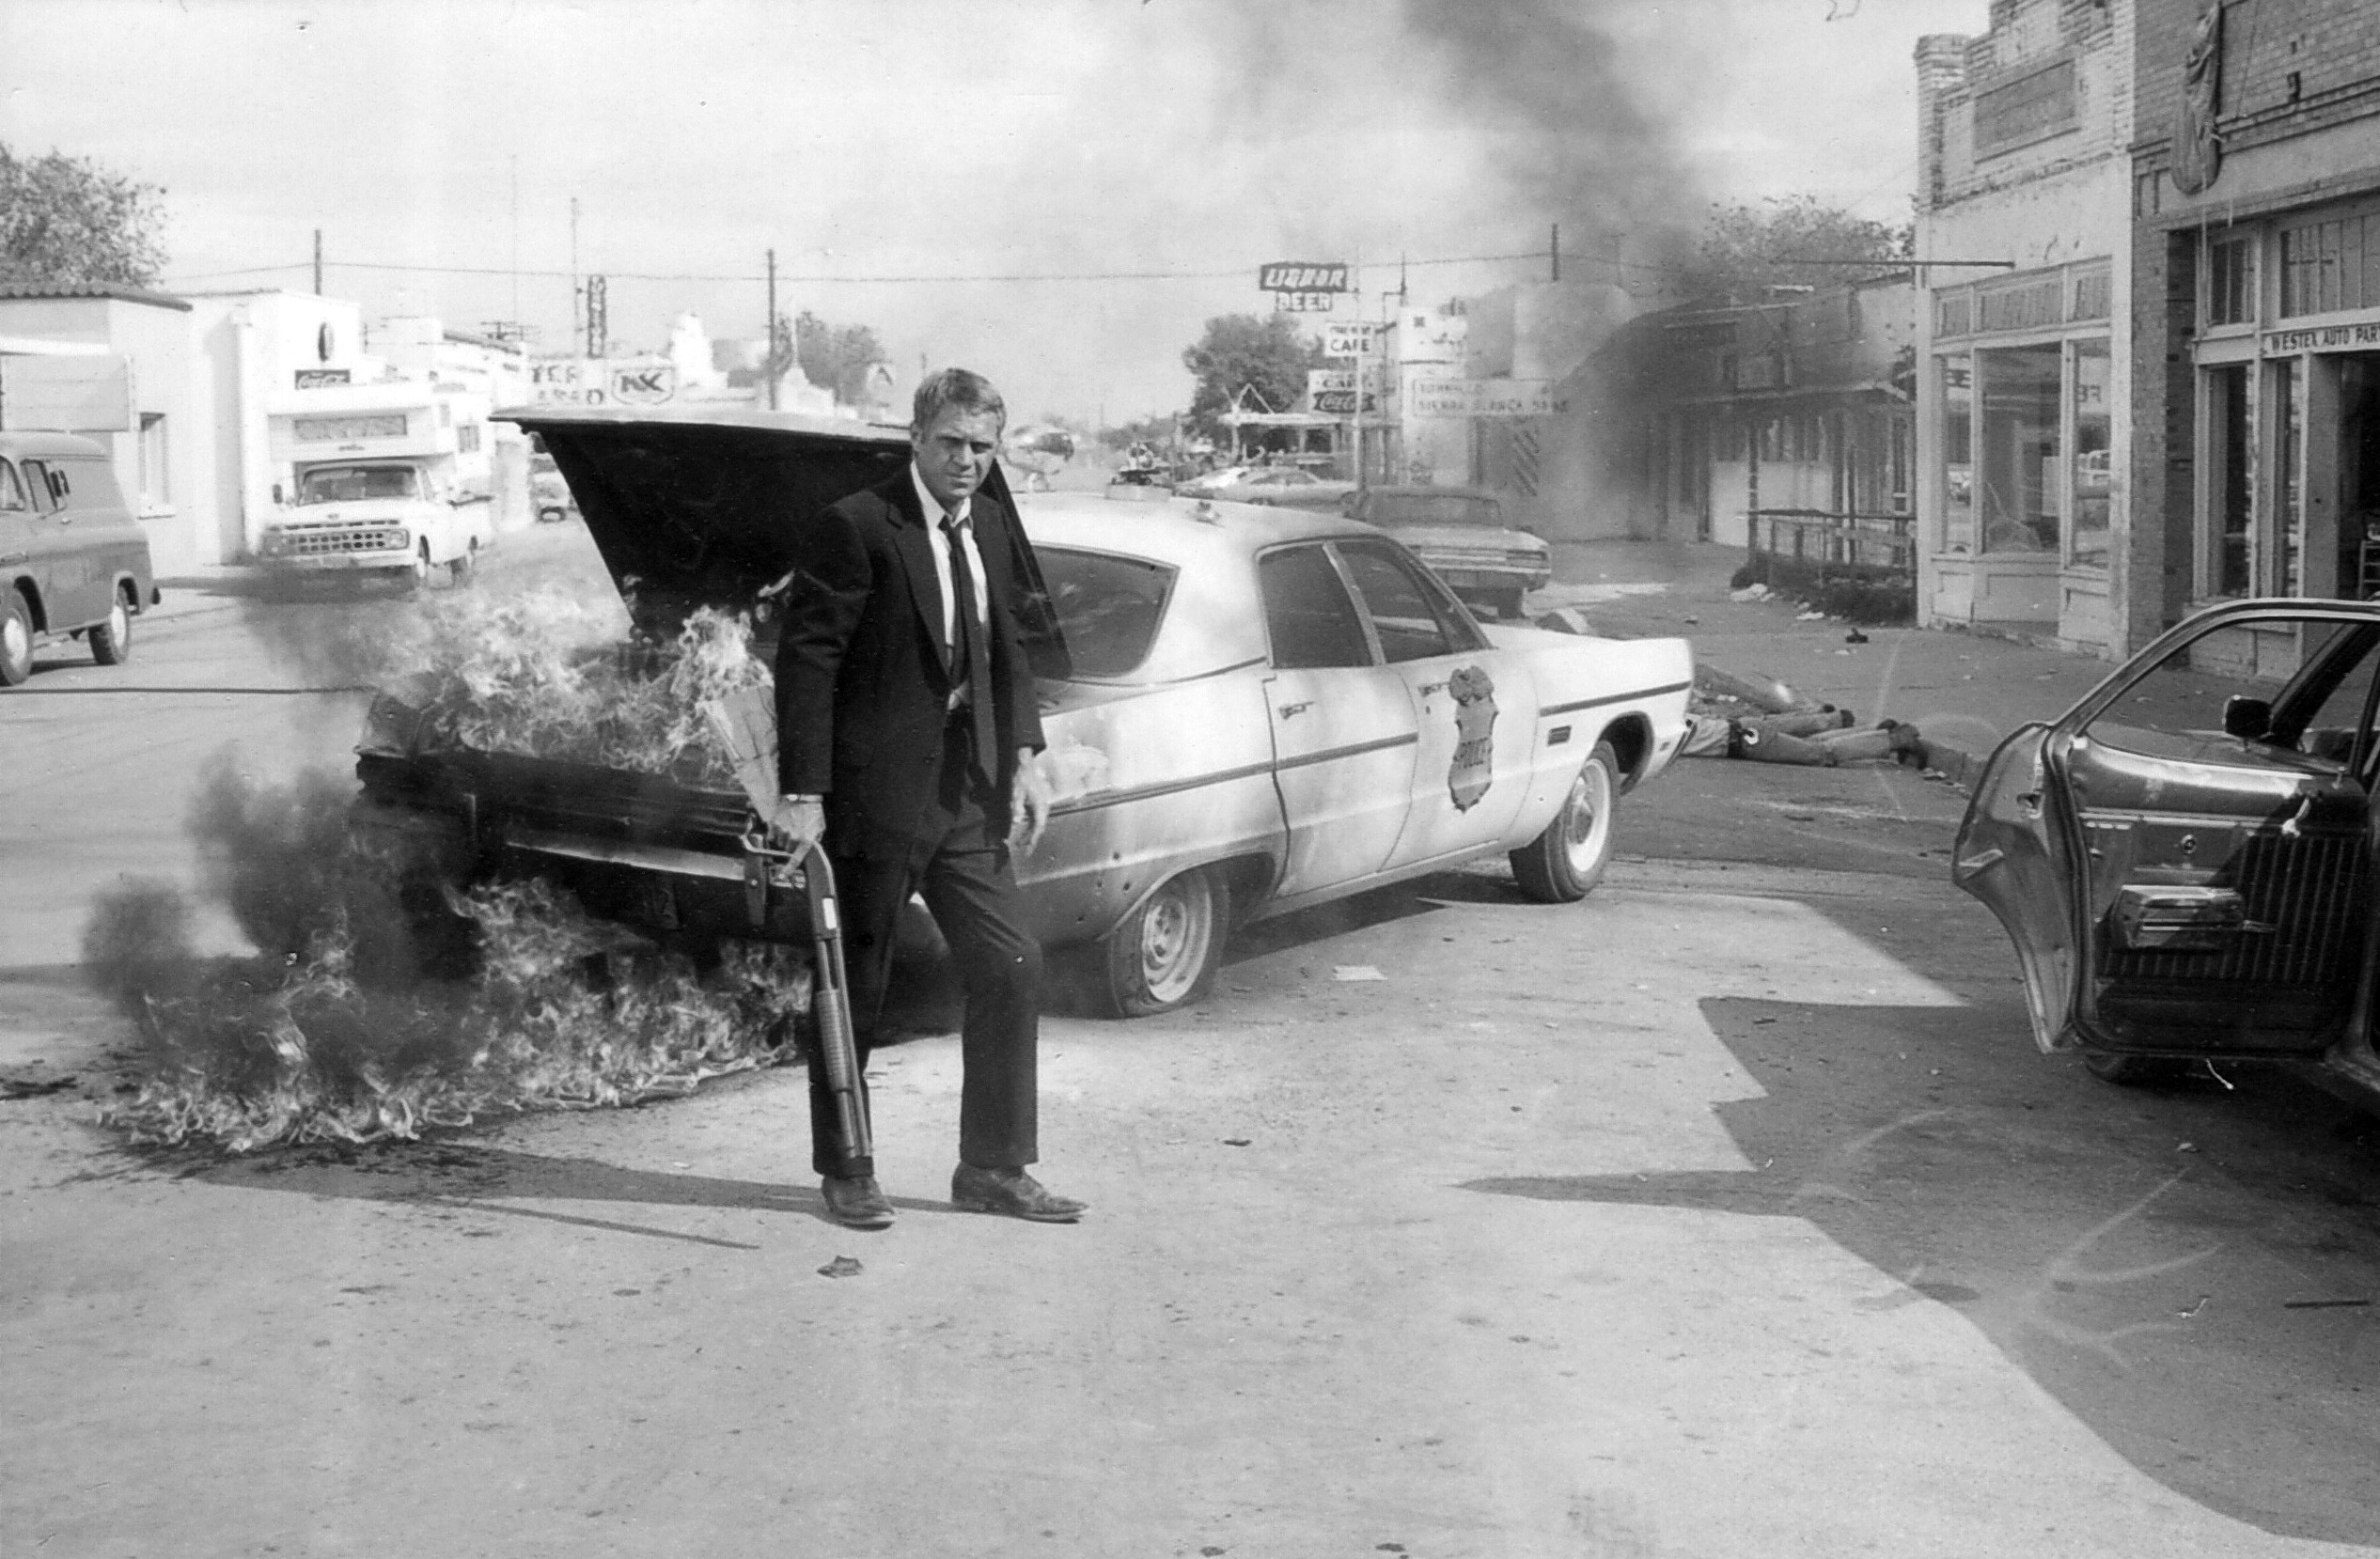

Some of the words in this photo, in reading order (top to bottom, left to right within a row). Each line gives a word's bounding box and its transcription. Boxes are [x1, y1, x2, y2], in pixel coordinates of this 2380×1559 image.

[1276, 291, 1331, 311] BEER
[1330, 338, 1370, 352] CAFE
[2324, 327, 2350, 346] AUTO
[2356, 324, 2380, 343] PAR
